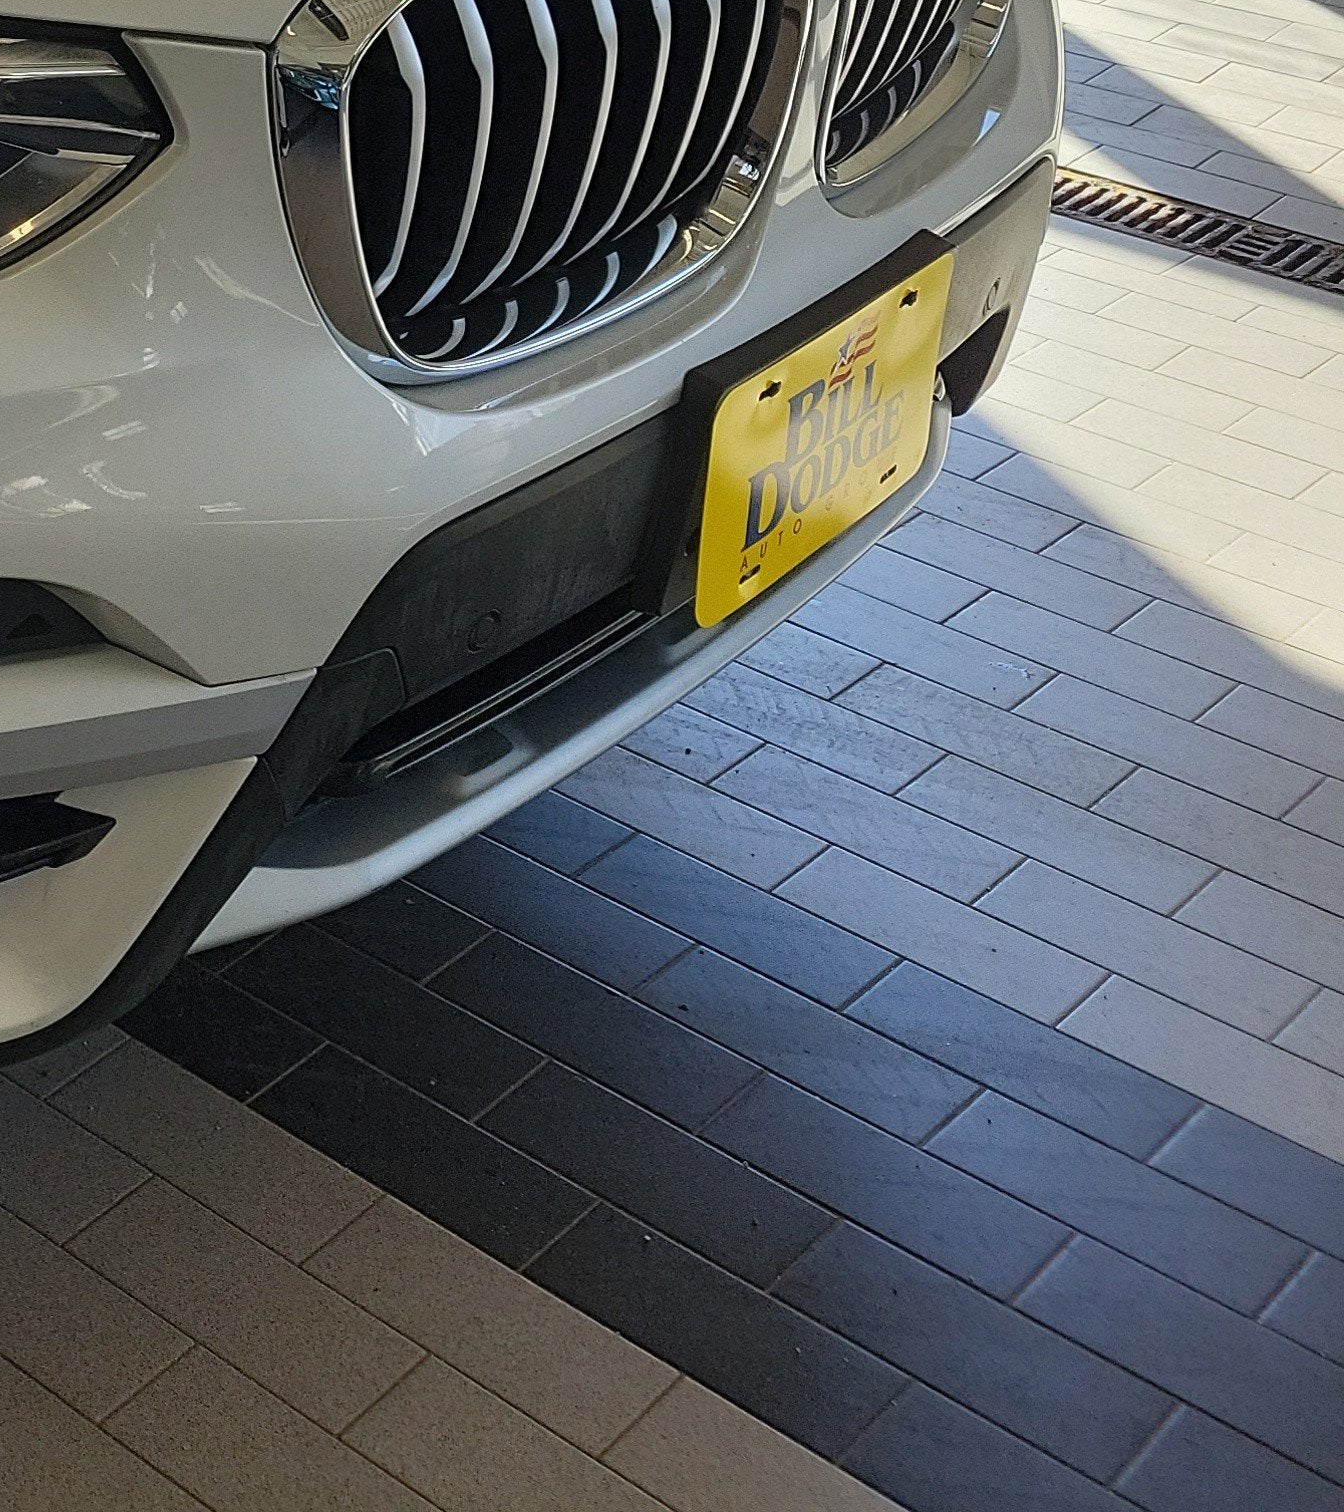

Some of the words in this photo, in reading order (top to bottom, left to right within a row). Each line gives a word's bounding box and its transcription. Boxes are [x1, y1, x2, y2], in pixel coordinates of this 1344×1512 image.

[784, 359, 884, 464] BILL
[740, 393, 905, 552] DODGE
[739, 518, 803, 572] AUTO
